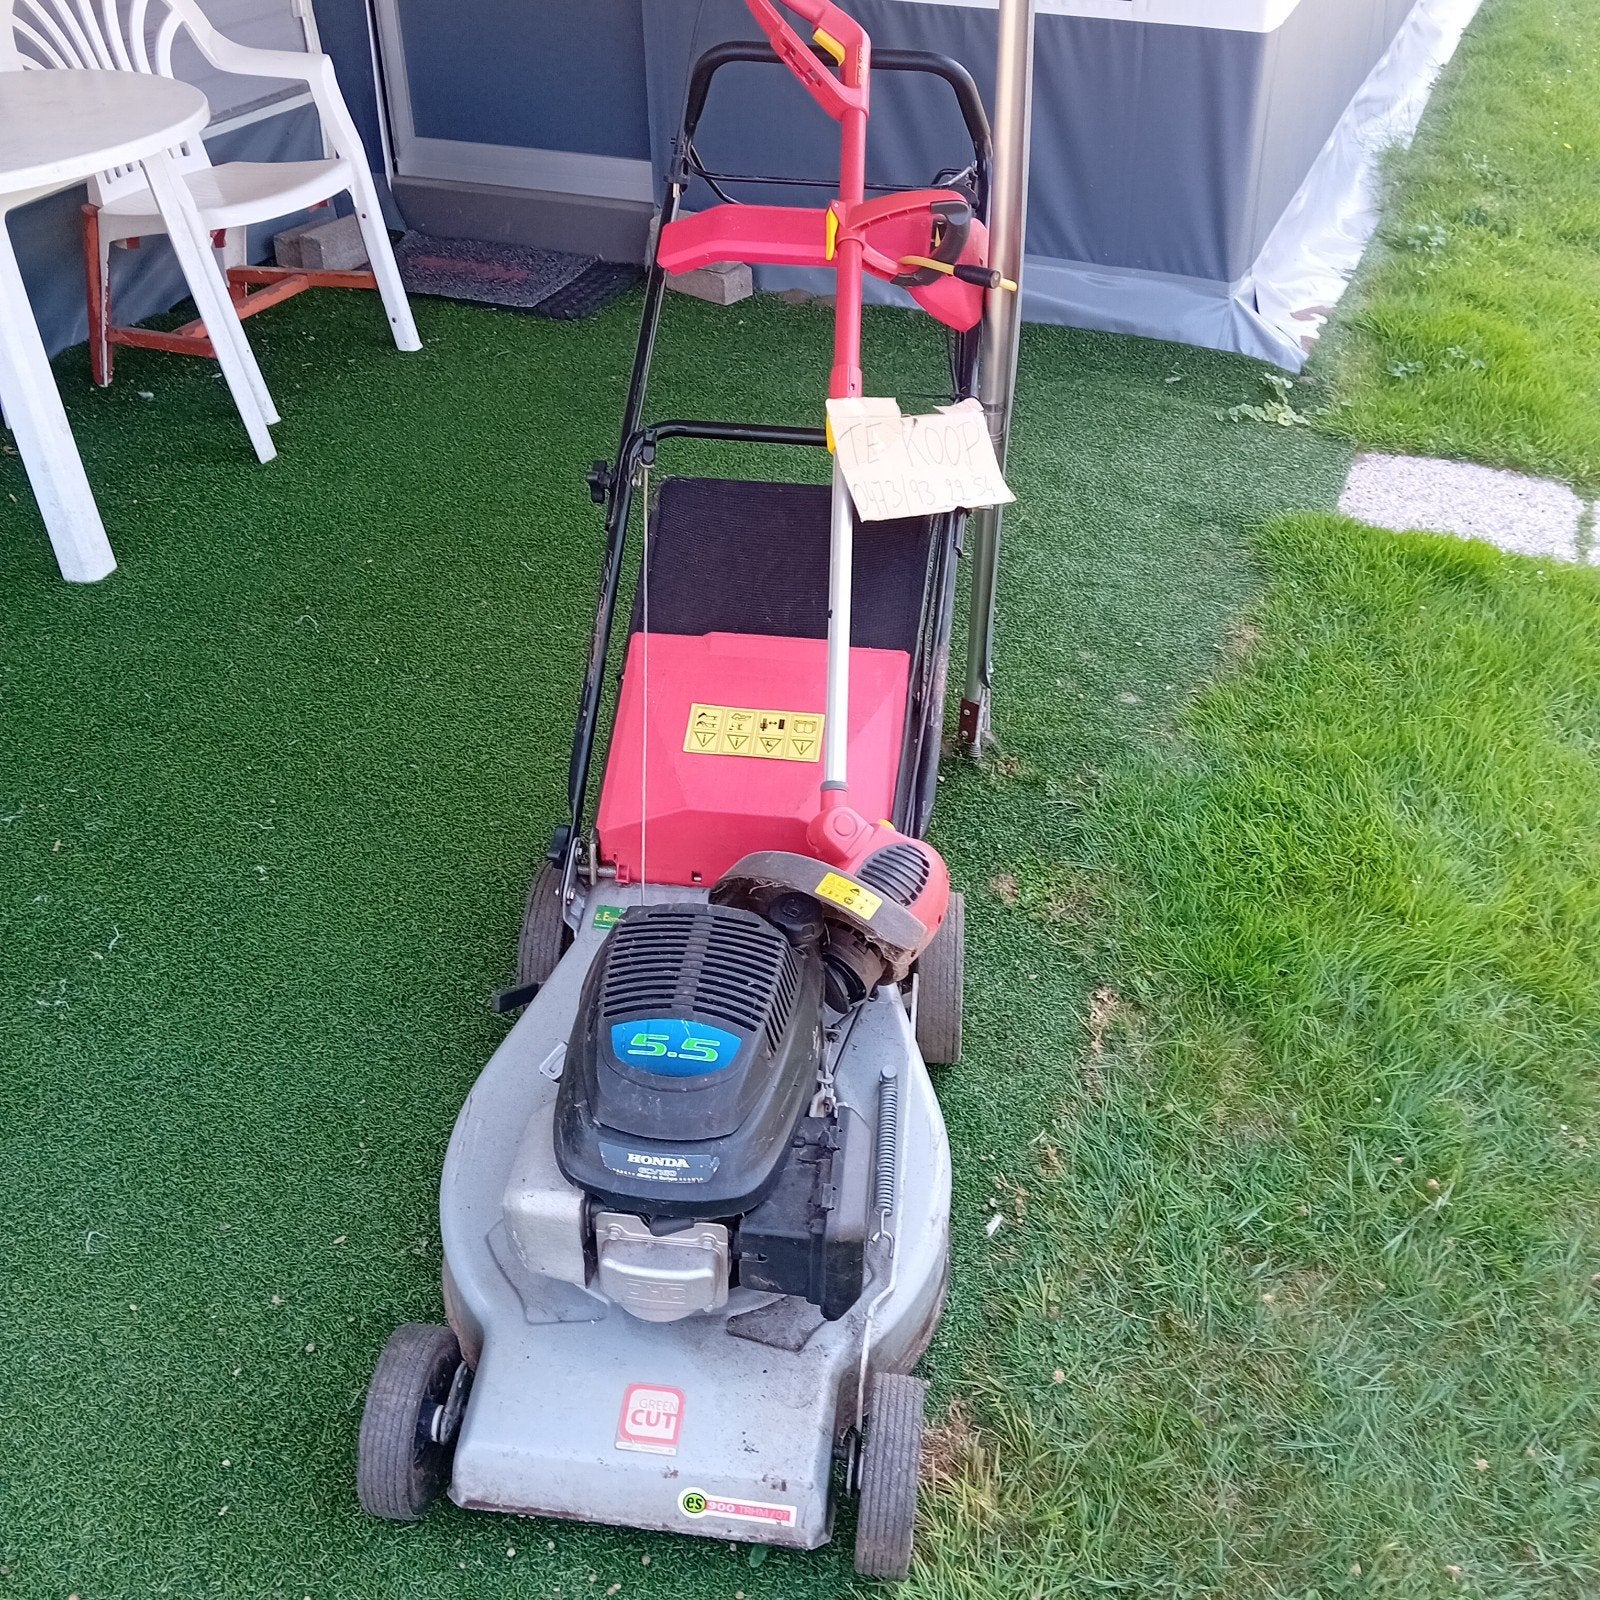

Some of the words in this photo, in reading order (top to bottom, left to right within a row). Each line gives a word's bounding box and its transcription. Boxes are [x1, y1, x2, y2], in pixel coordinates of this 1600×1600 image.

[838, 422, 882, 466] TE
[900, 418, 981, 467] KOOP
[627, 1033, 721, 1062] 5.5
[627, 1152, 690, 1169] HONDA
[638, 1398, 677, 1412] GREEN
[630, 1408, 678, 1430] CUT
[685, 1496, 703, 1510] es
[708, 1501, 736, 1513] 900
